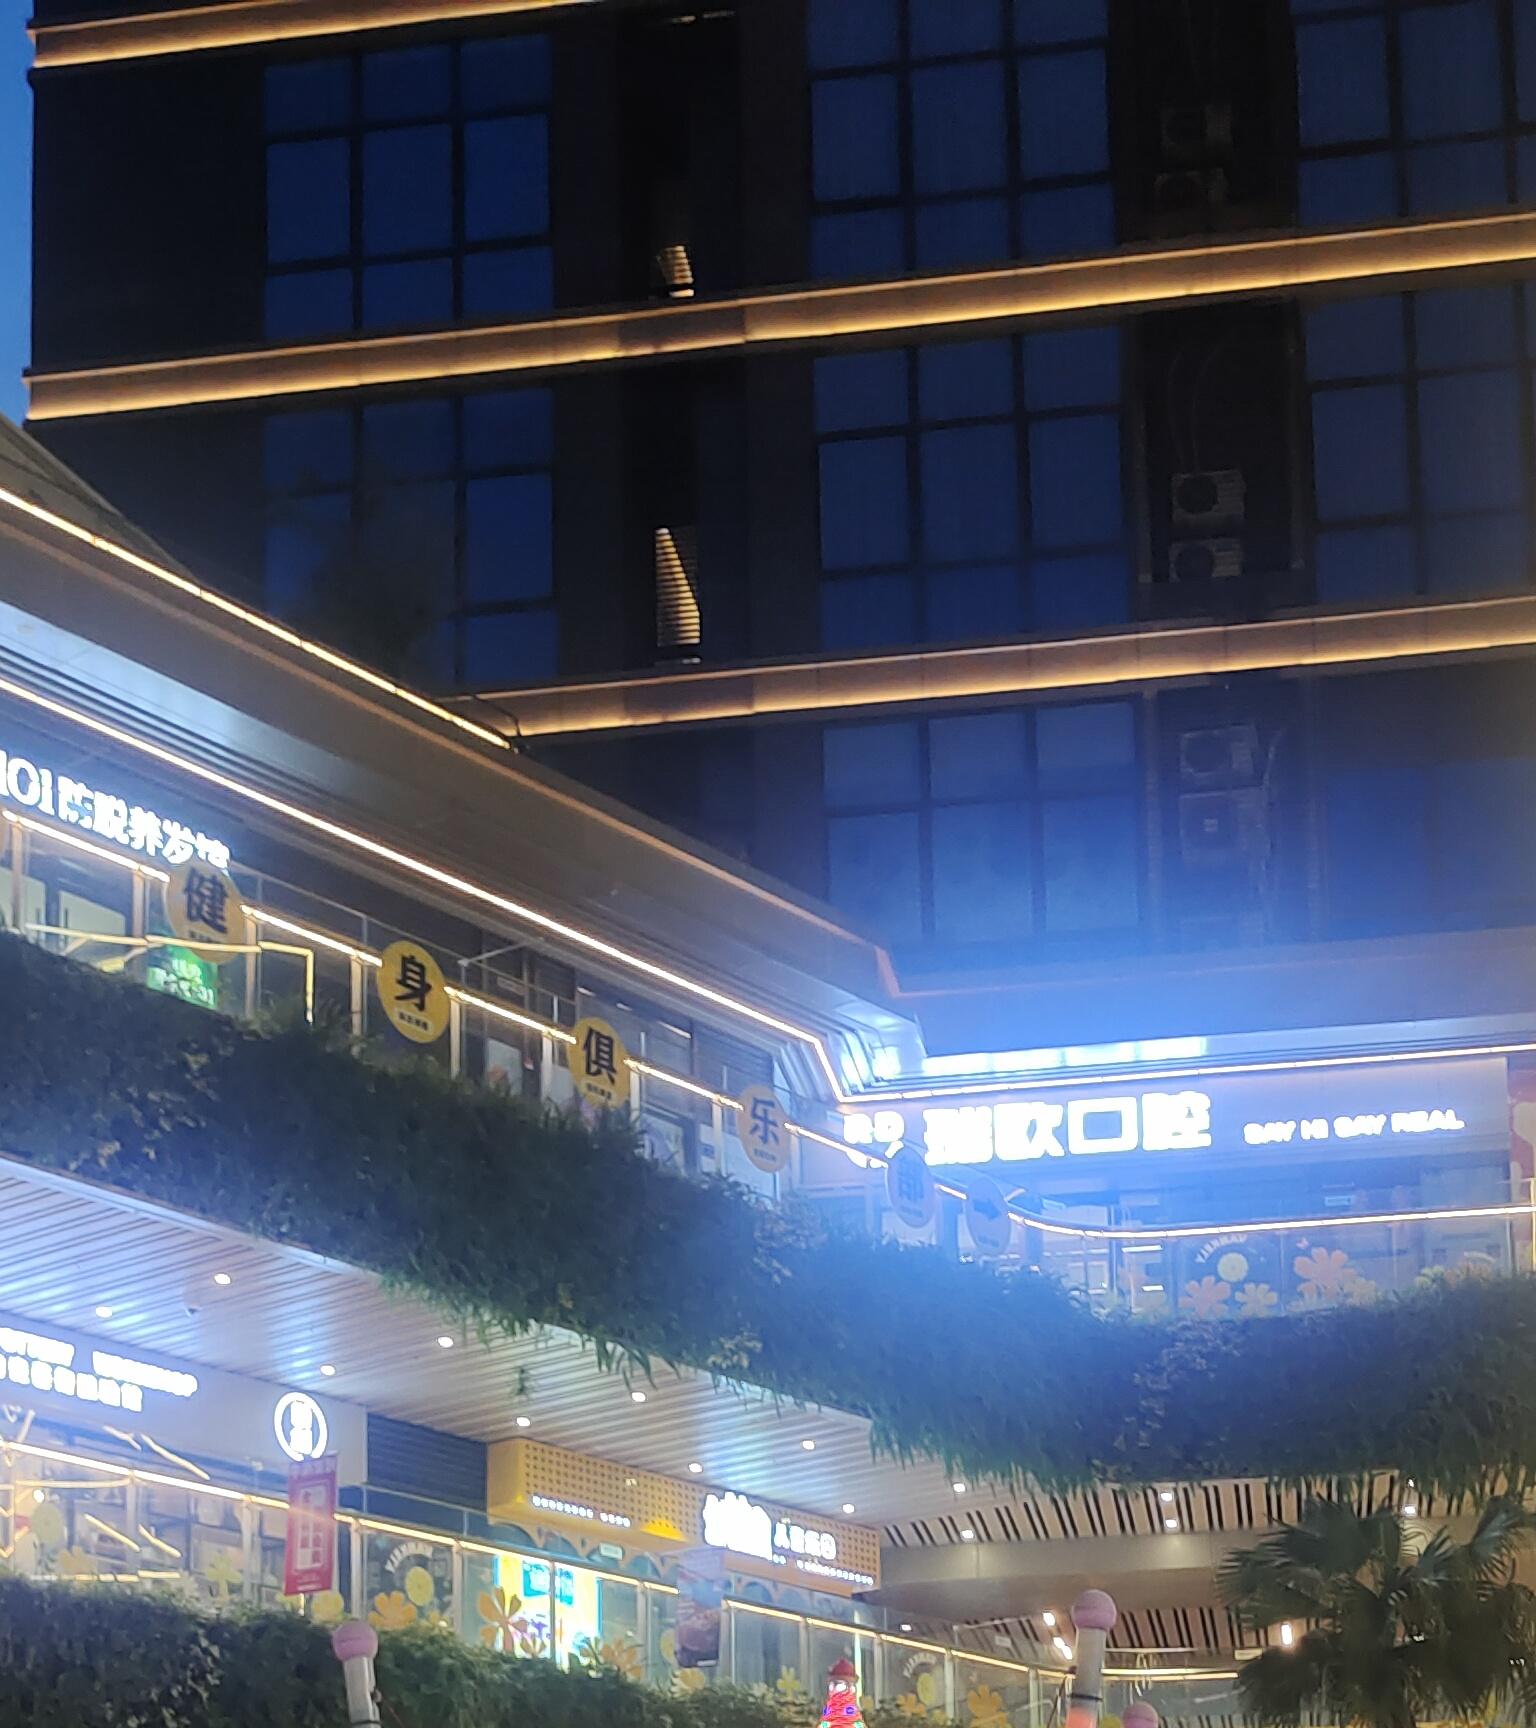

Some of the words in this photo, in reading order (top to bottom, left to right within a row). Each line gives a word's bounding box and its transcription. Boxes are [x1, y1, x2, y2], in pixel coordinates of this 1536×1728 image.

[184, 867, 230, 934] 健
[395, 955, 432, 1012] 身
[584, 1027, 618, 1085] 俱
[750, 1098, 782, 1146] 乐
